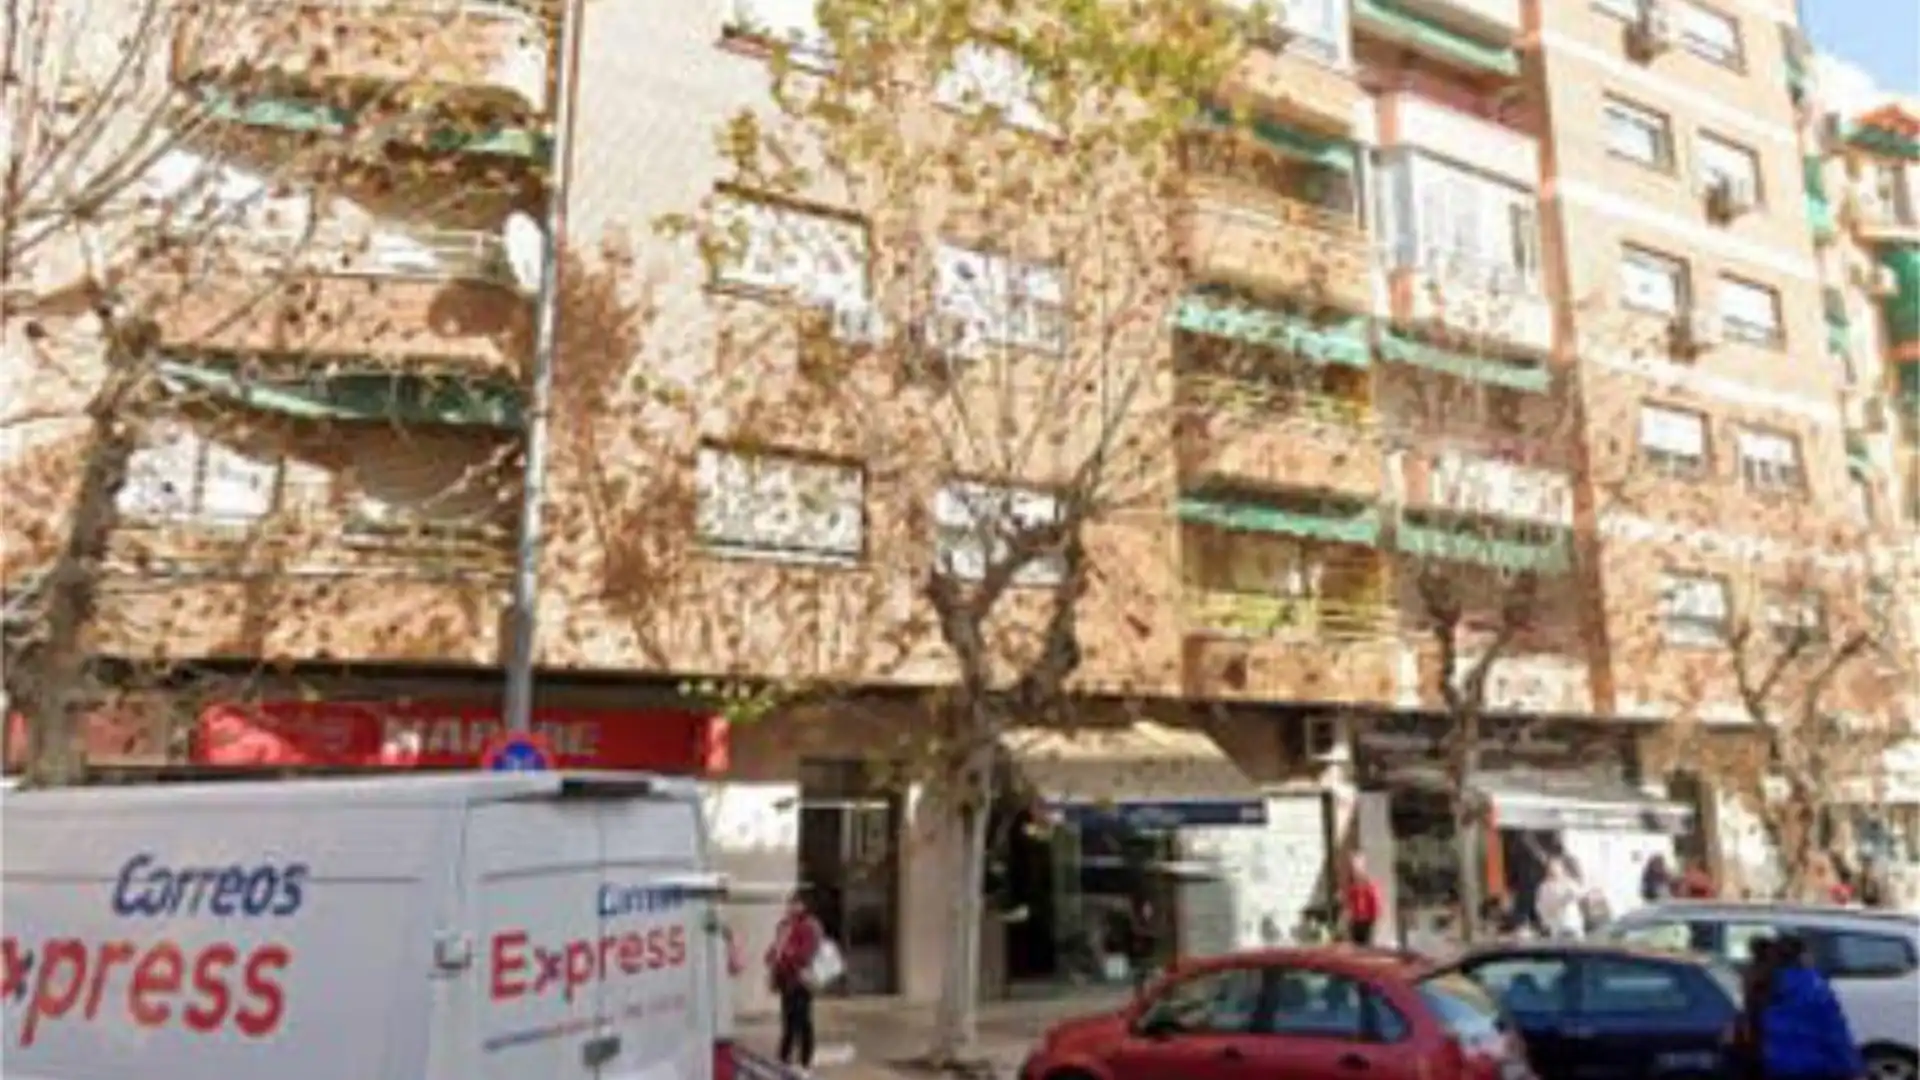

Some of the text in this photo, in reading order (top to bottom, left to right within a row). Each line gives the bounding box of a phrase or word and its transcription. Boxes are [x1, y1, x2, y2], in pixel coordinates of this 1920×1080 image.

[383, 717, 602, 757] MAPRE
[112, 853, 309, 916] Correos
[0, 937, 291, 1046] xpress
[491, 924, 686, 1004] Express
